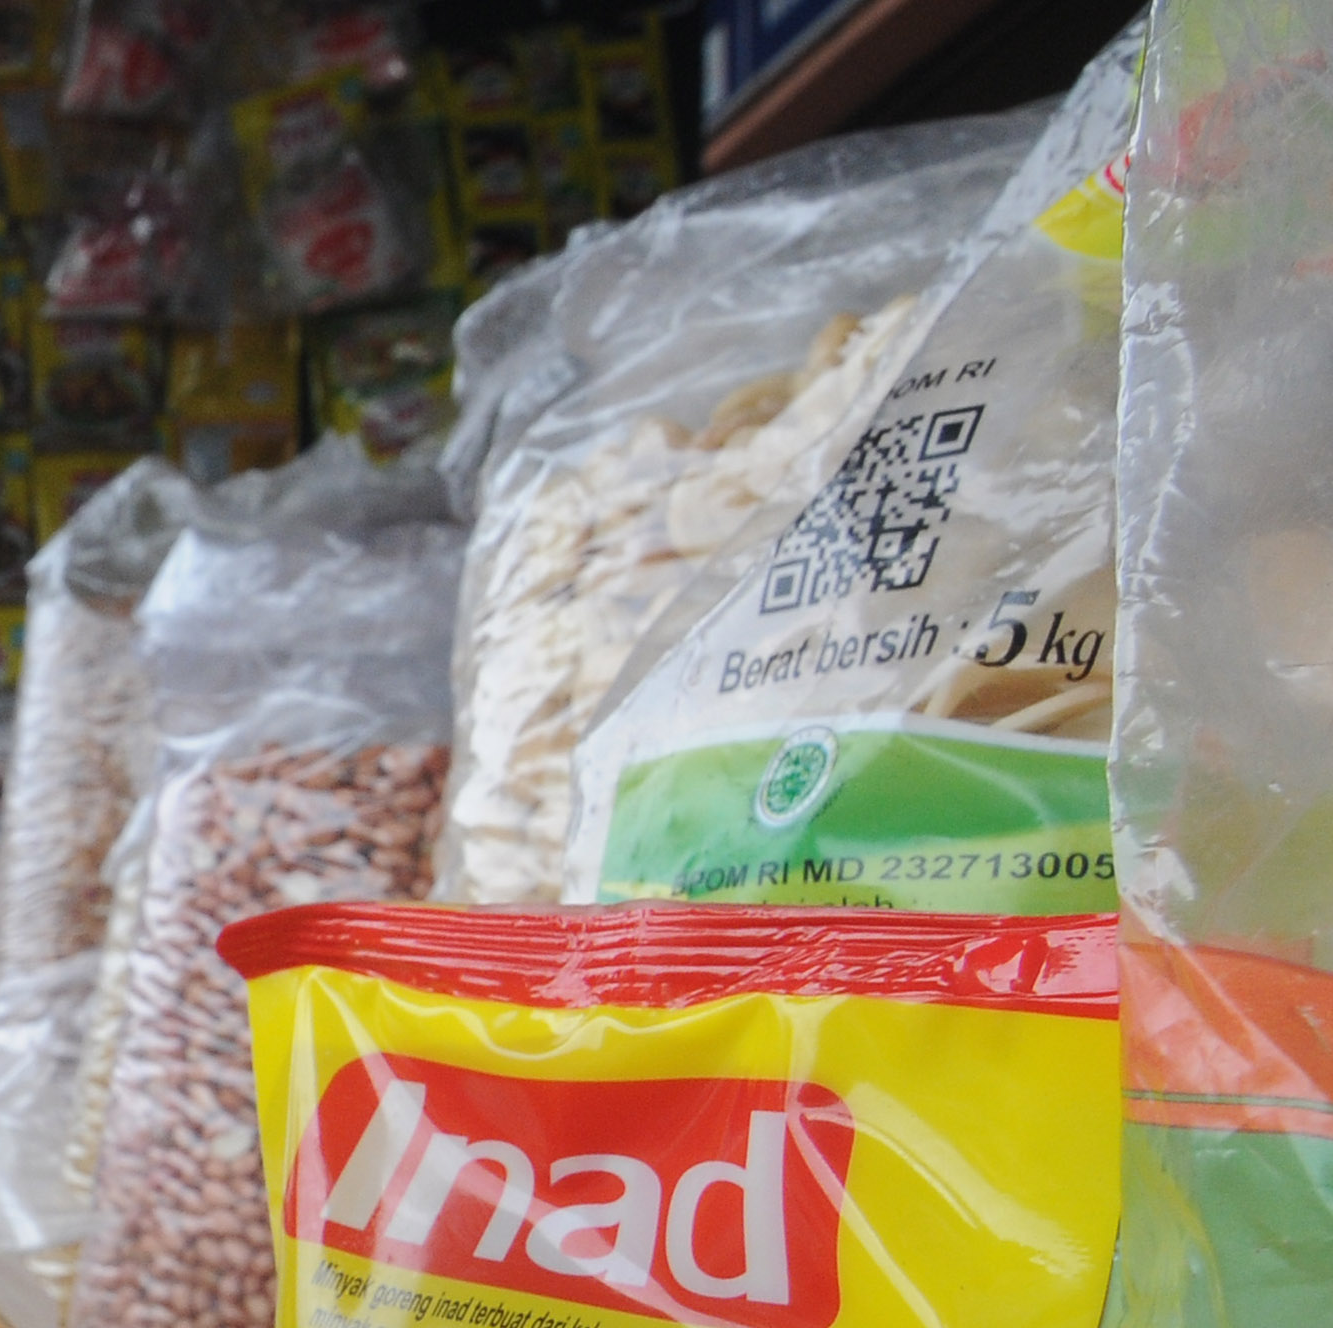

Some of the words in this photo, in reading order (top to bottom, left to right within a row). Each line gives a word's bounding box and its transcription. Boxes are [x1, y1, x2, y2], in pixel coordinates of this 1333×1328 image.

[958, 357, 997, 383] RI
[719, 645, 807, 695] Berat
[816, 615, 938, 675] bersih
[1036, 611, 1105, 681] kg
[671, 862, 751, 897] BPOM
[758, 860, 791, 884] RI
[803, 857, 866, 883] MD
[320, 1078, 790, 1305] Inad
[311, 1260, 371, 1299] Minyak
[373, 1281, 432, 1321] goreng
[434, 1291, 468, 1323] inad
